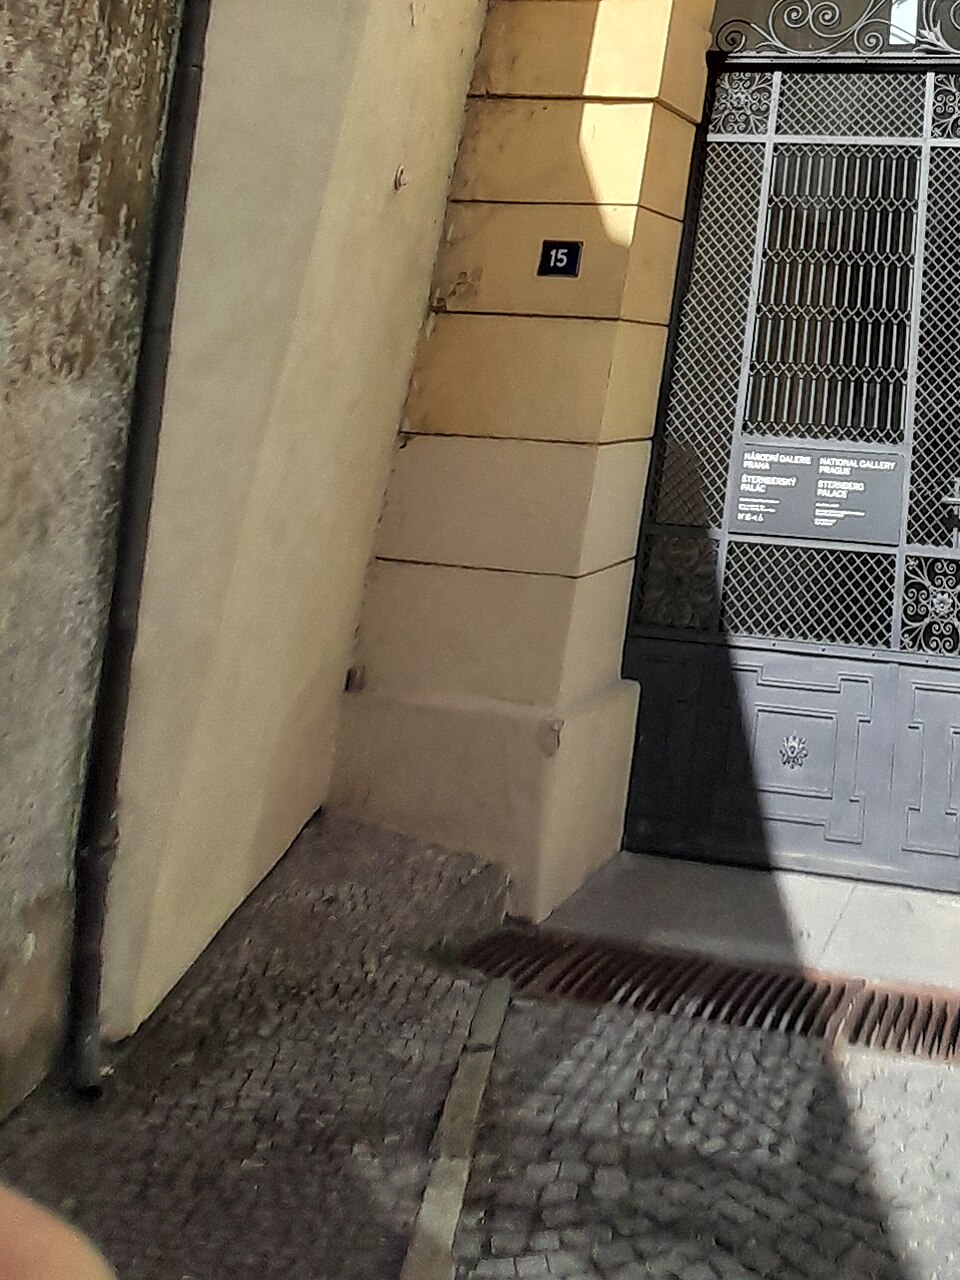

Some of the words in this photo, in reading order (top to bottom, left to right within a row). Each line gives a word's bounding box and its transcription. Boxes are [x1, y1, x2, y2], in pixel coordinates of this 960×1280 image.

[549, 248, 568, 268] 15
[819, 456, 859, 468] NATIONAL
[859, 459, 896, 470] GALLERY
[819, 465, 851, 475] PRAGUE
[816, 488, 848, 499] PALACE
